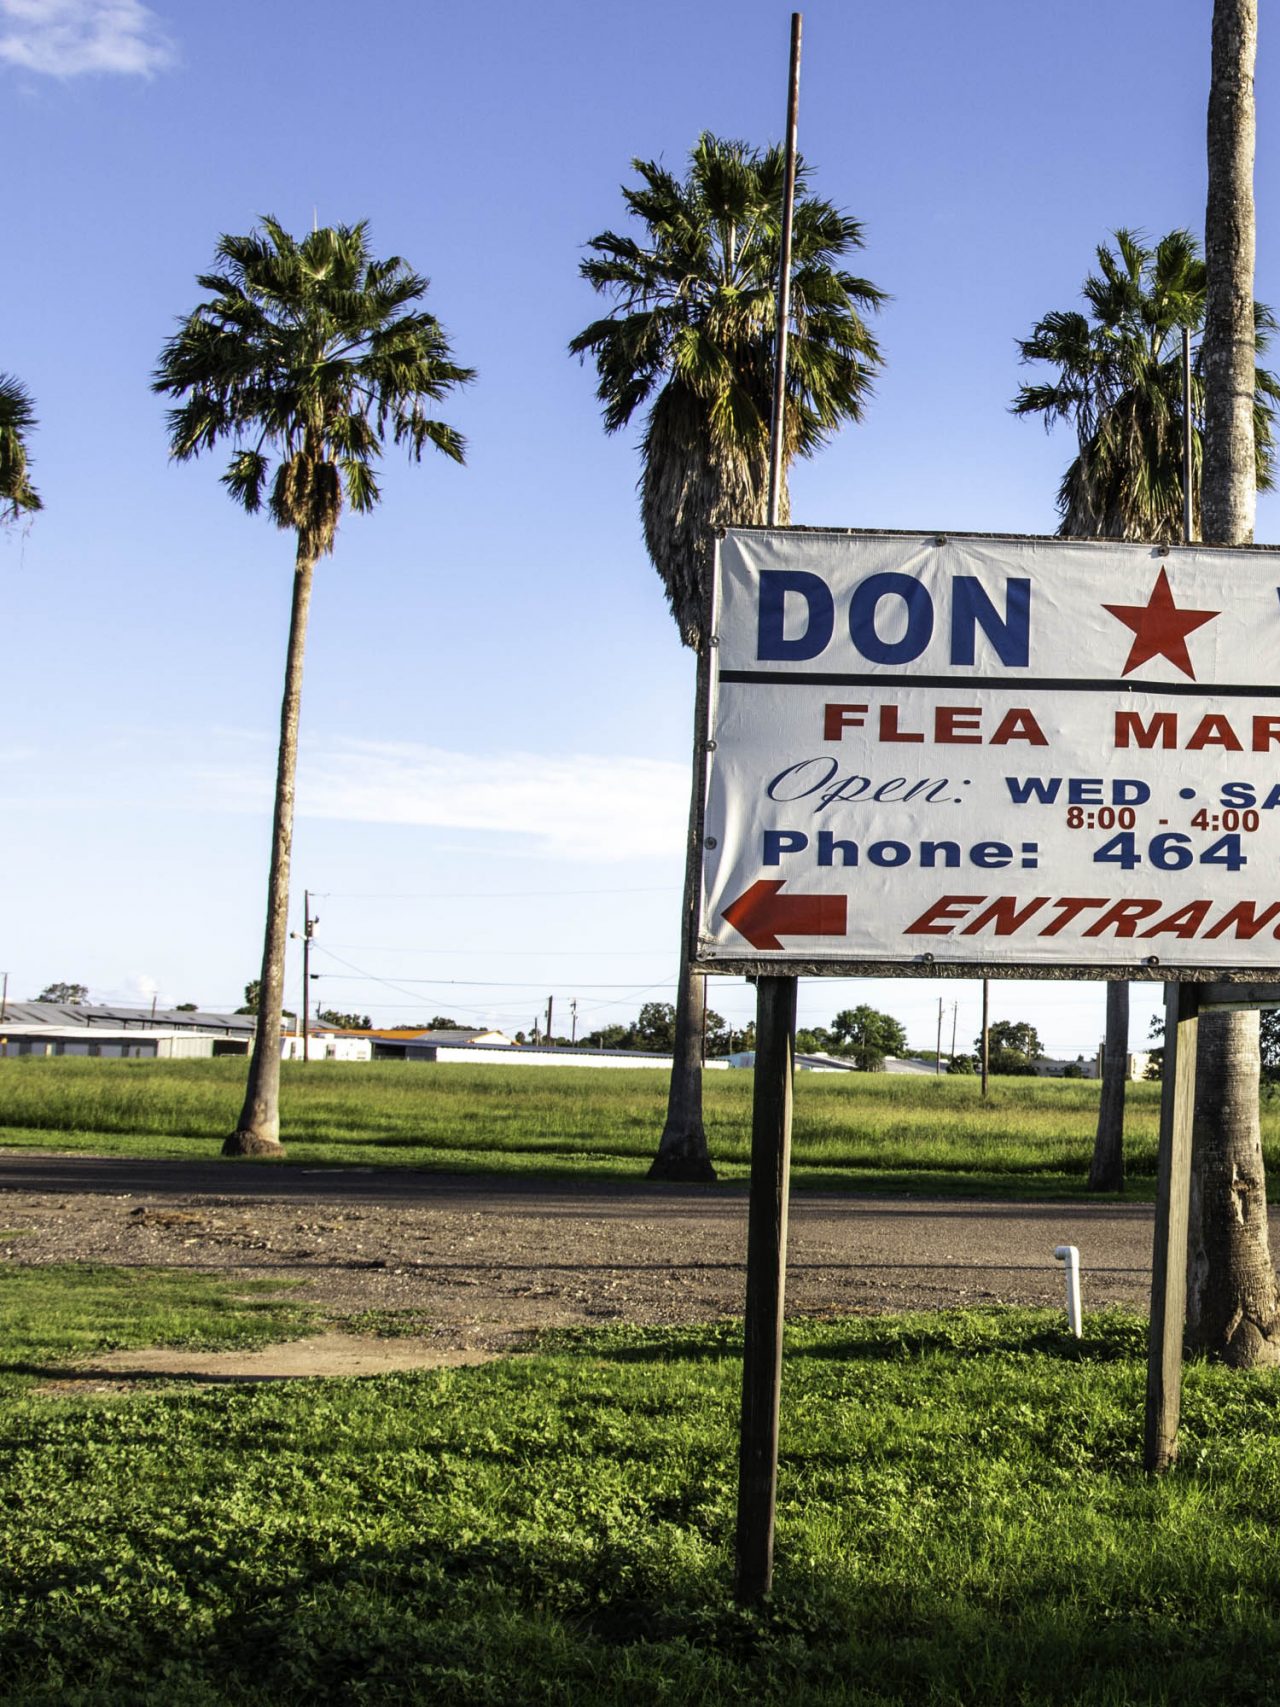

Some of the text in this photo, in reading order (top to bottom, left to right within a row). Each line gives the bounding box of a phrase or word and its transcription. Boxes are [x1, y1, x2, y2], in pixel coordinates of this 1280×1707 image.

[757, 569, 1031, 669] DON
[823, 703, 1050, 747] FLEA
[767, 756, 972, 813] Open:
[1004, 776, 1152, 806] WED
[1066, 806, 1137, 831] 8:00
[1190, 808, 1260, 833] 4:00
[762, 830, 1039, 869] Phone:
[1093, 831, 1248, 871] 464
